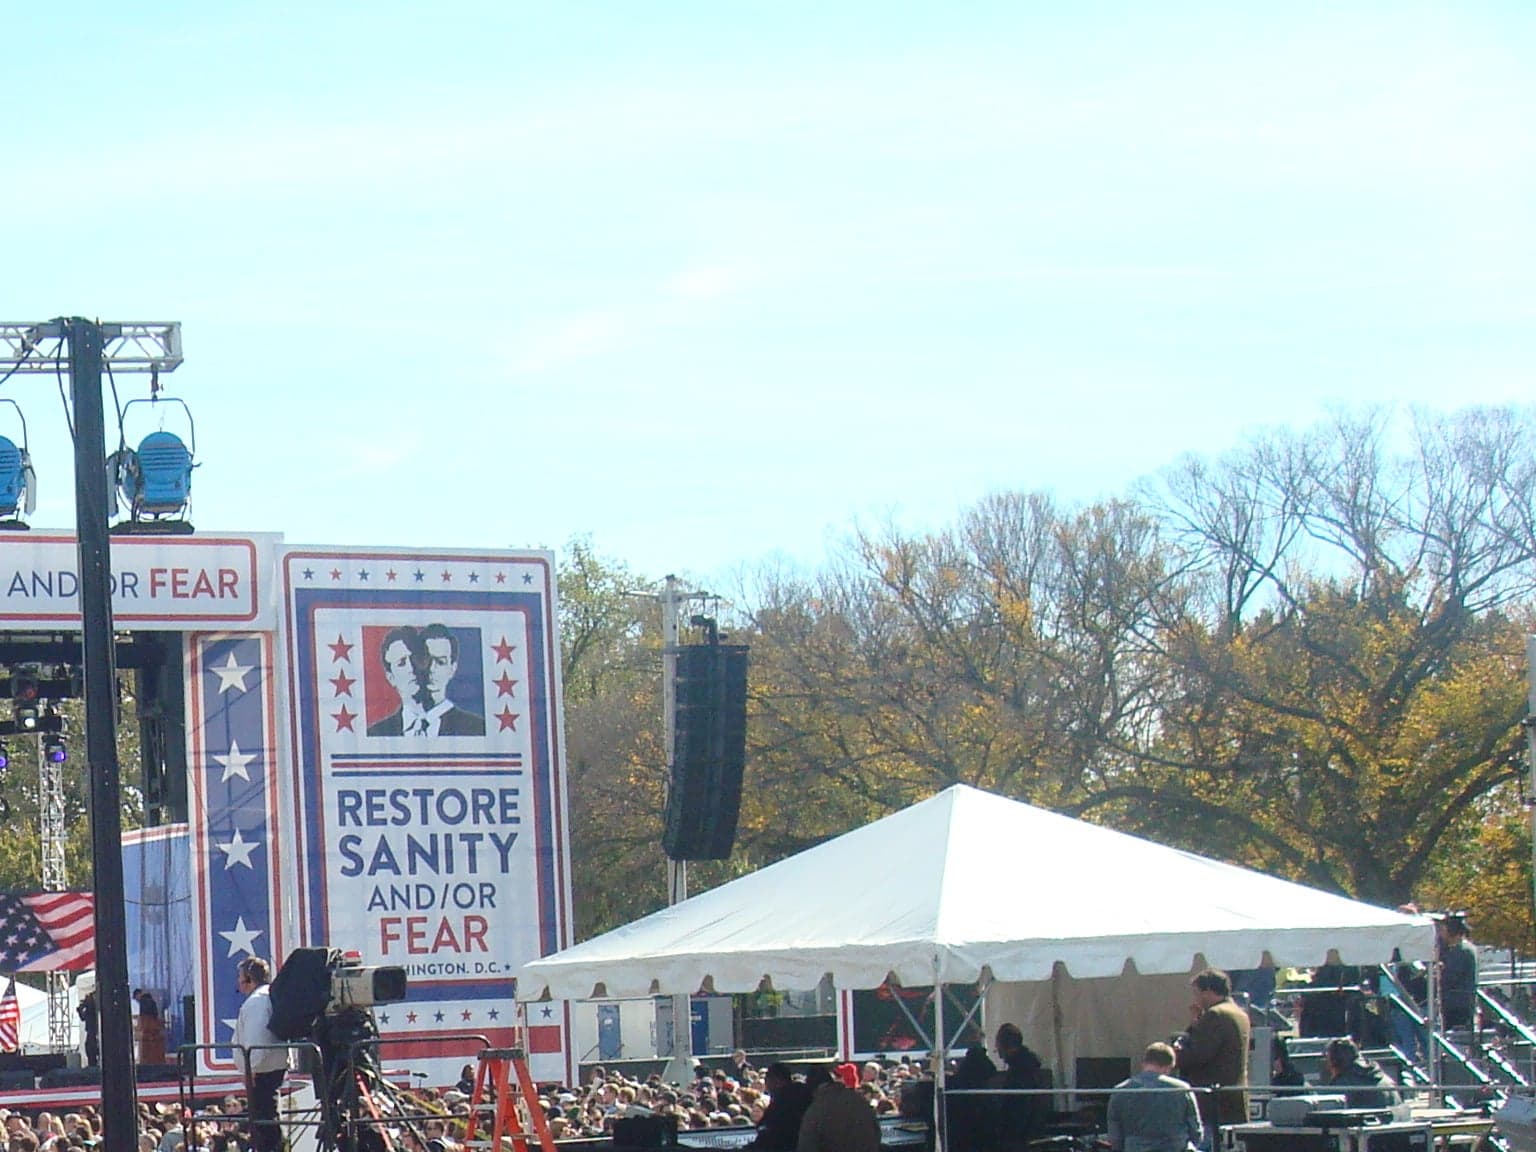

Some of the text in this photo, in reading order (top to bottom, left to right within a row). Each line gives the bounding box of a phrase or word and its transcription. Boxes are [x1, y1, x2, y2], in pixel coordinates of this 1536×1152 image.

[150, 567, 239, 599] FEAR
[337, 788, 521, 827] RESTORE
[338, 831, 519, 878] SANITY
[367, 882, 497, 912] AND/OR
[380, 914, 489, 956] FEAR
[474, 961, 502, 975] D.C.
